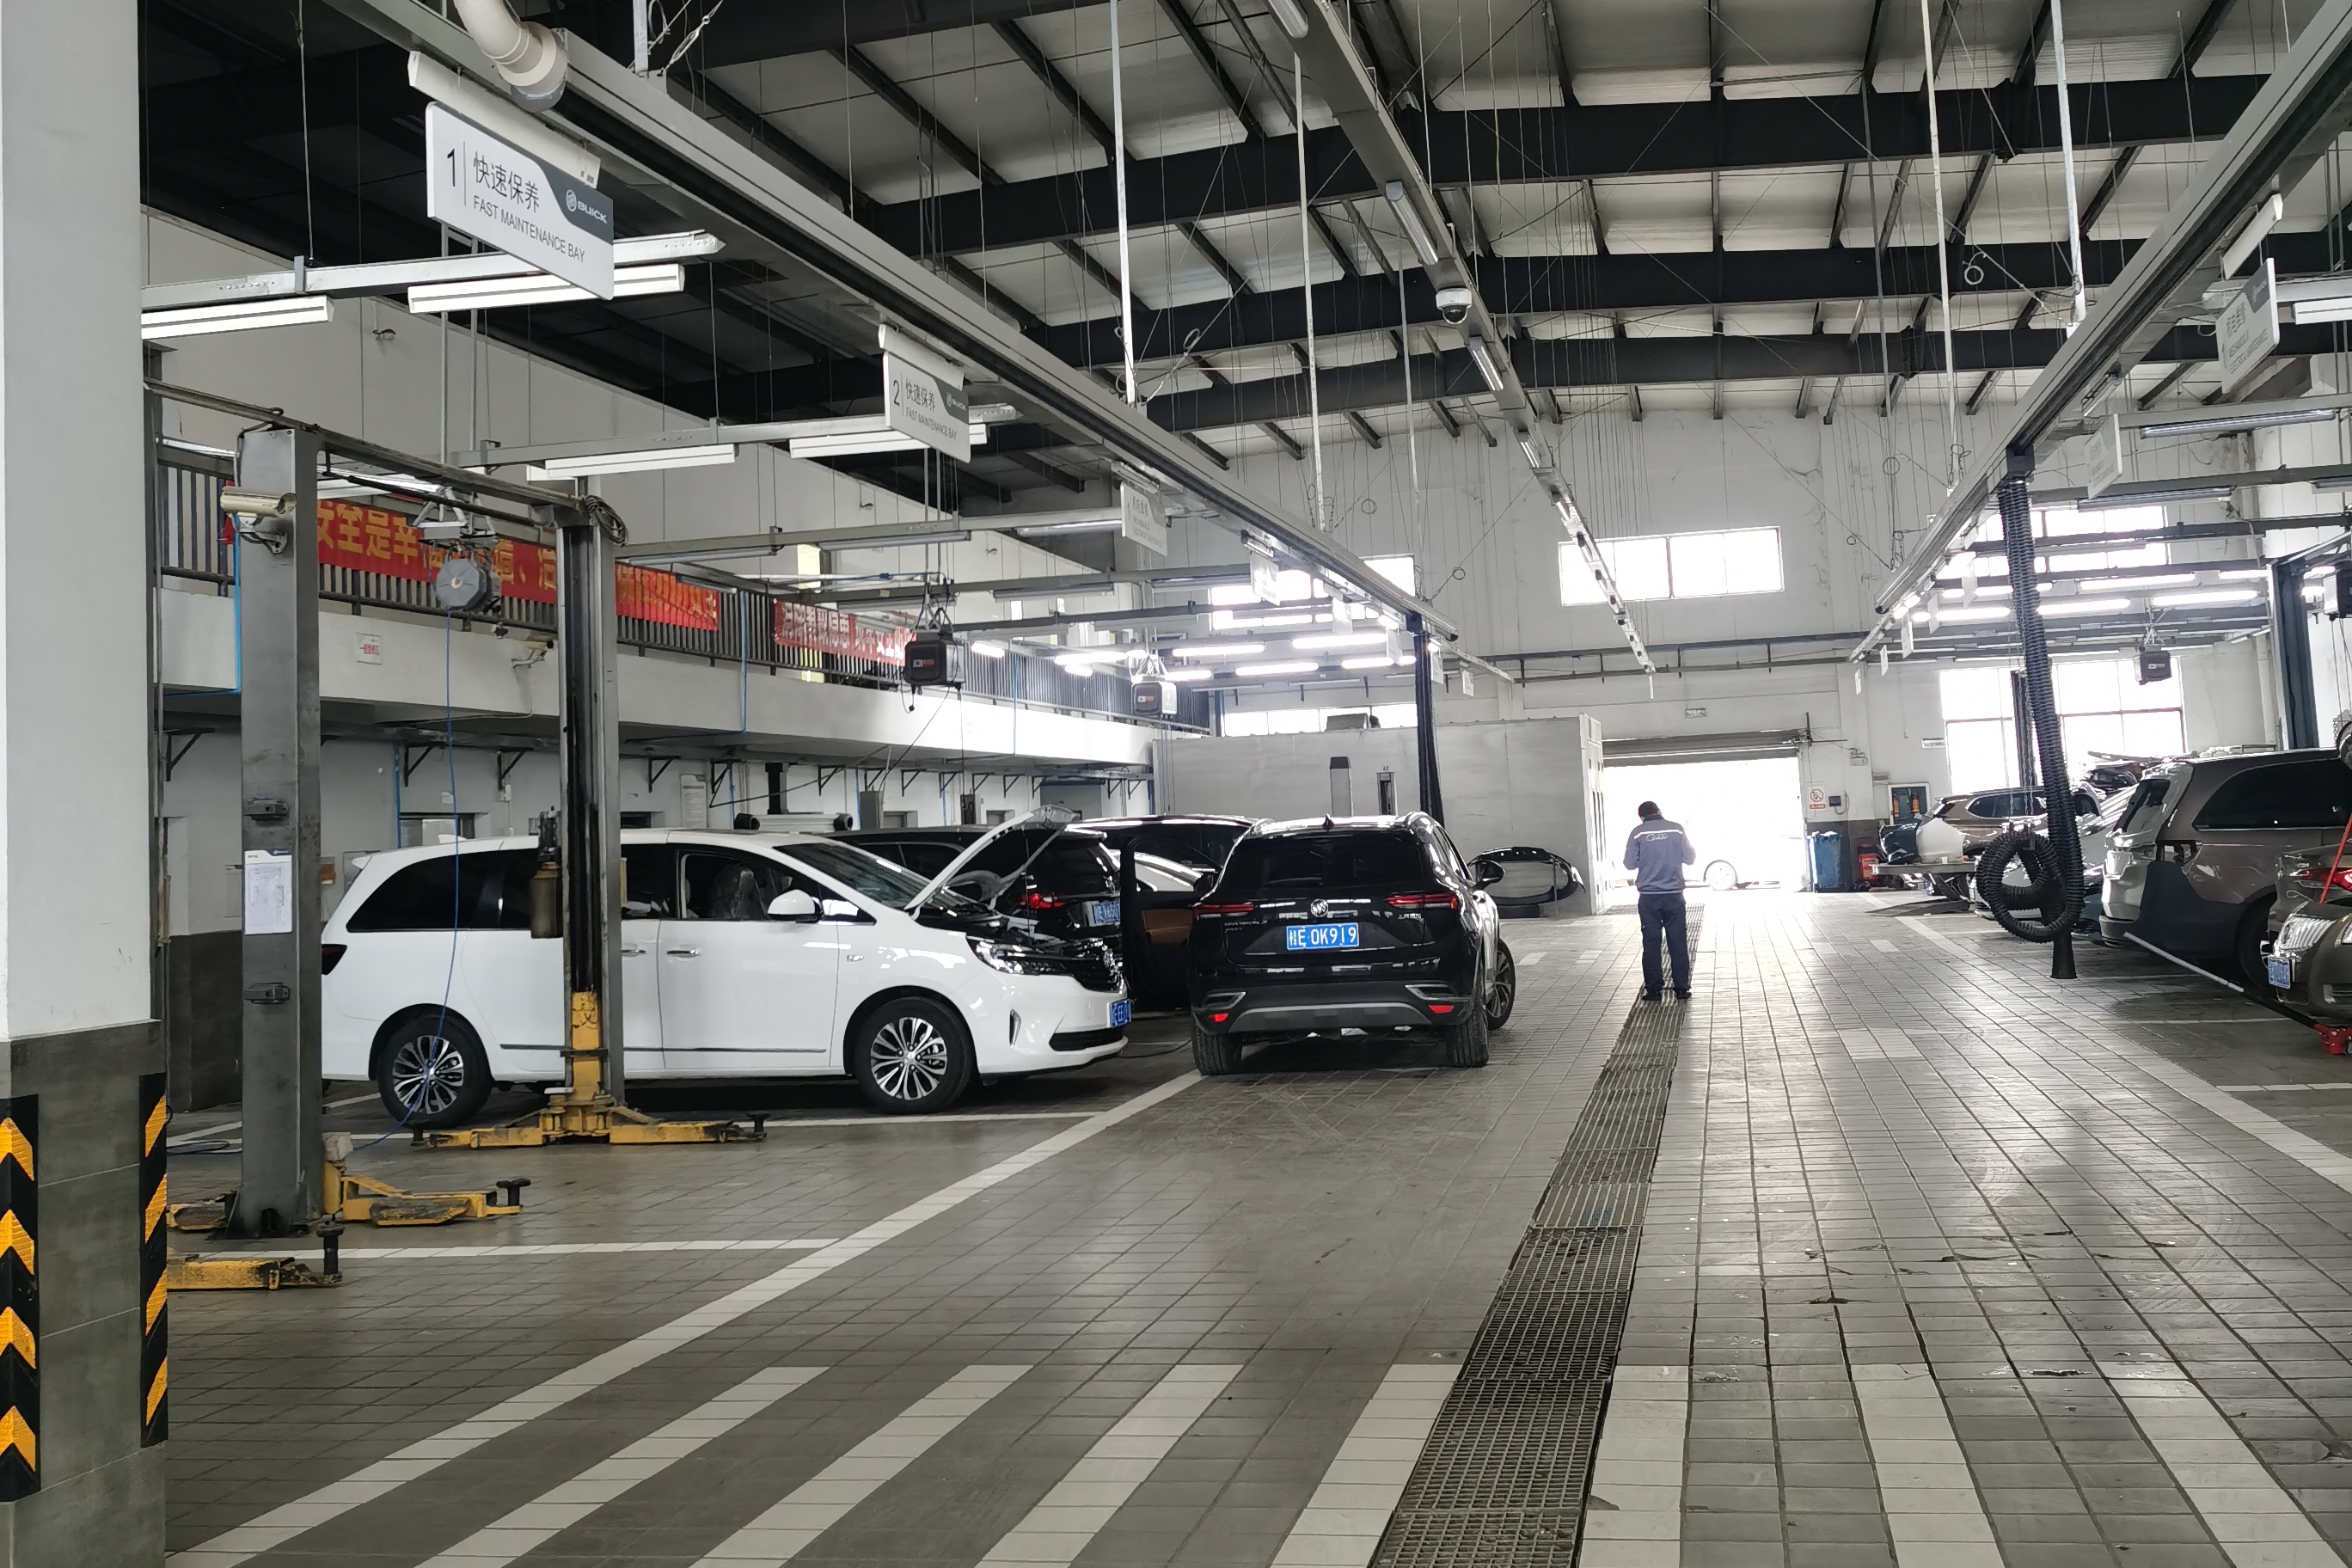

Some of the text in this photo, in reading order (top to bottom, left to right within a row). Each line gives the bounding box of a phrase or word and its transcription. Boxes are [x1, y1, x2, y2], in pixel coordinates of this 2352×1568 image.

[447, 148, 456, 187] 1
[474, 151, 539, 212] 快速保养
[473, 195, 585, 263] FAST MAINTENANCE BAY
[577, 200, 609, 225] BUICK
[892, 379, 901, 407] 2
[905, 377, 936, 413] 快速保养
[905, 407, 918, 422] FAST
